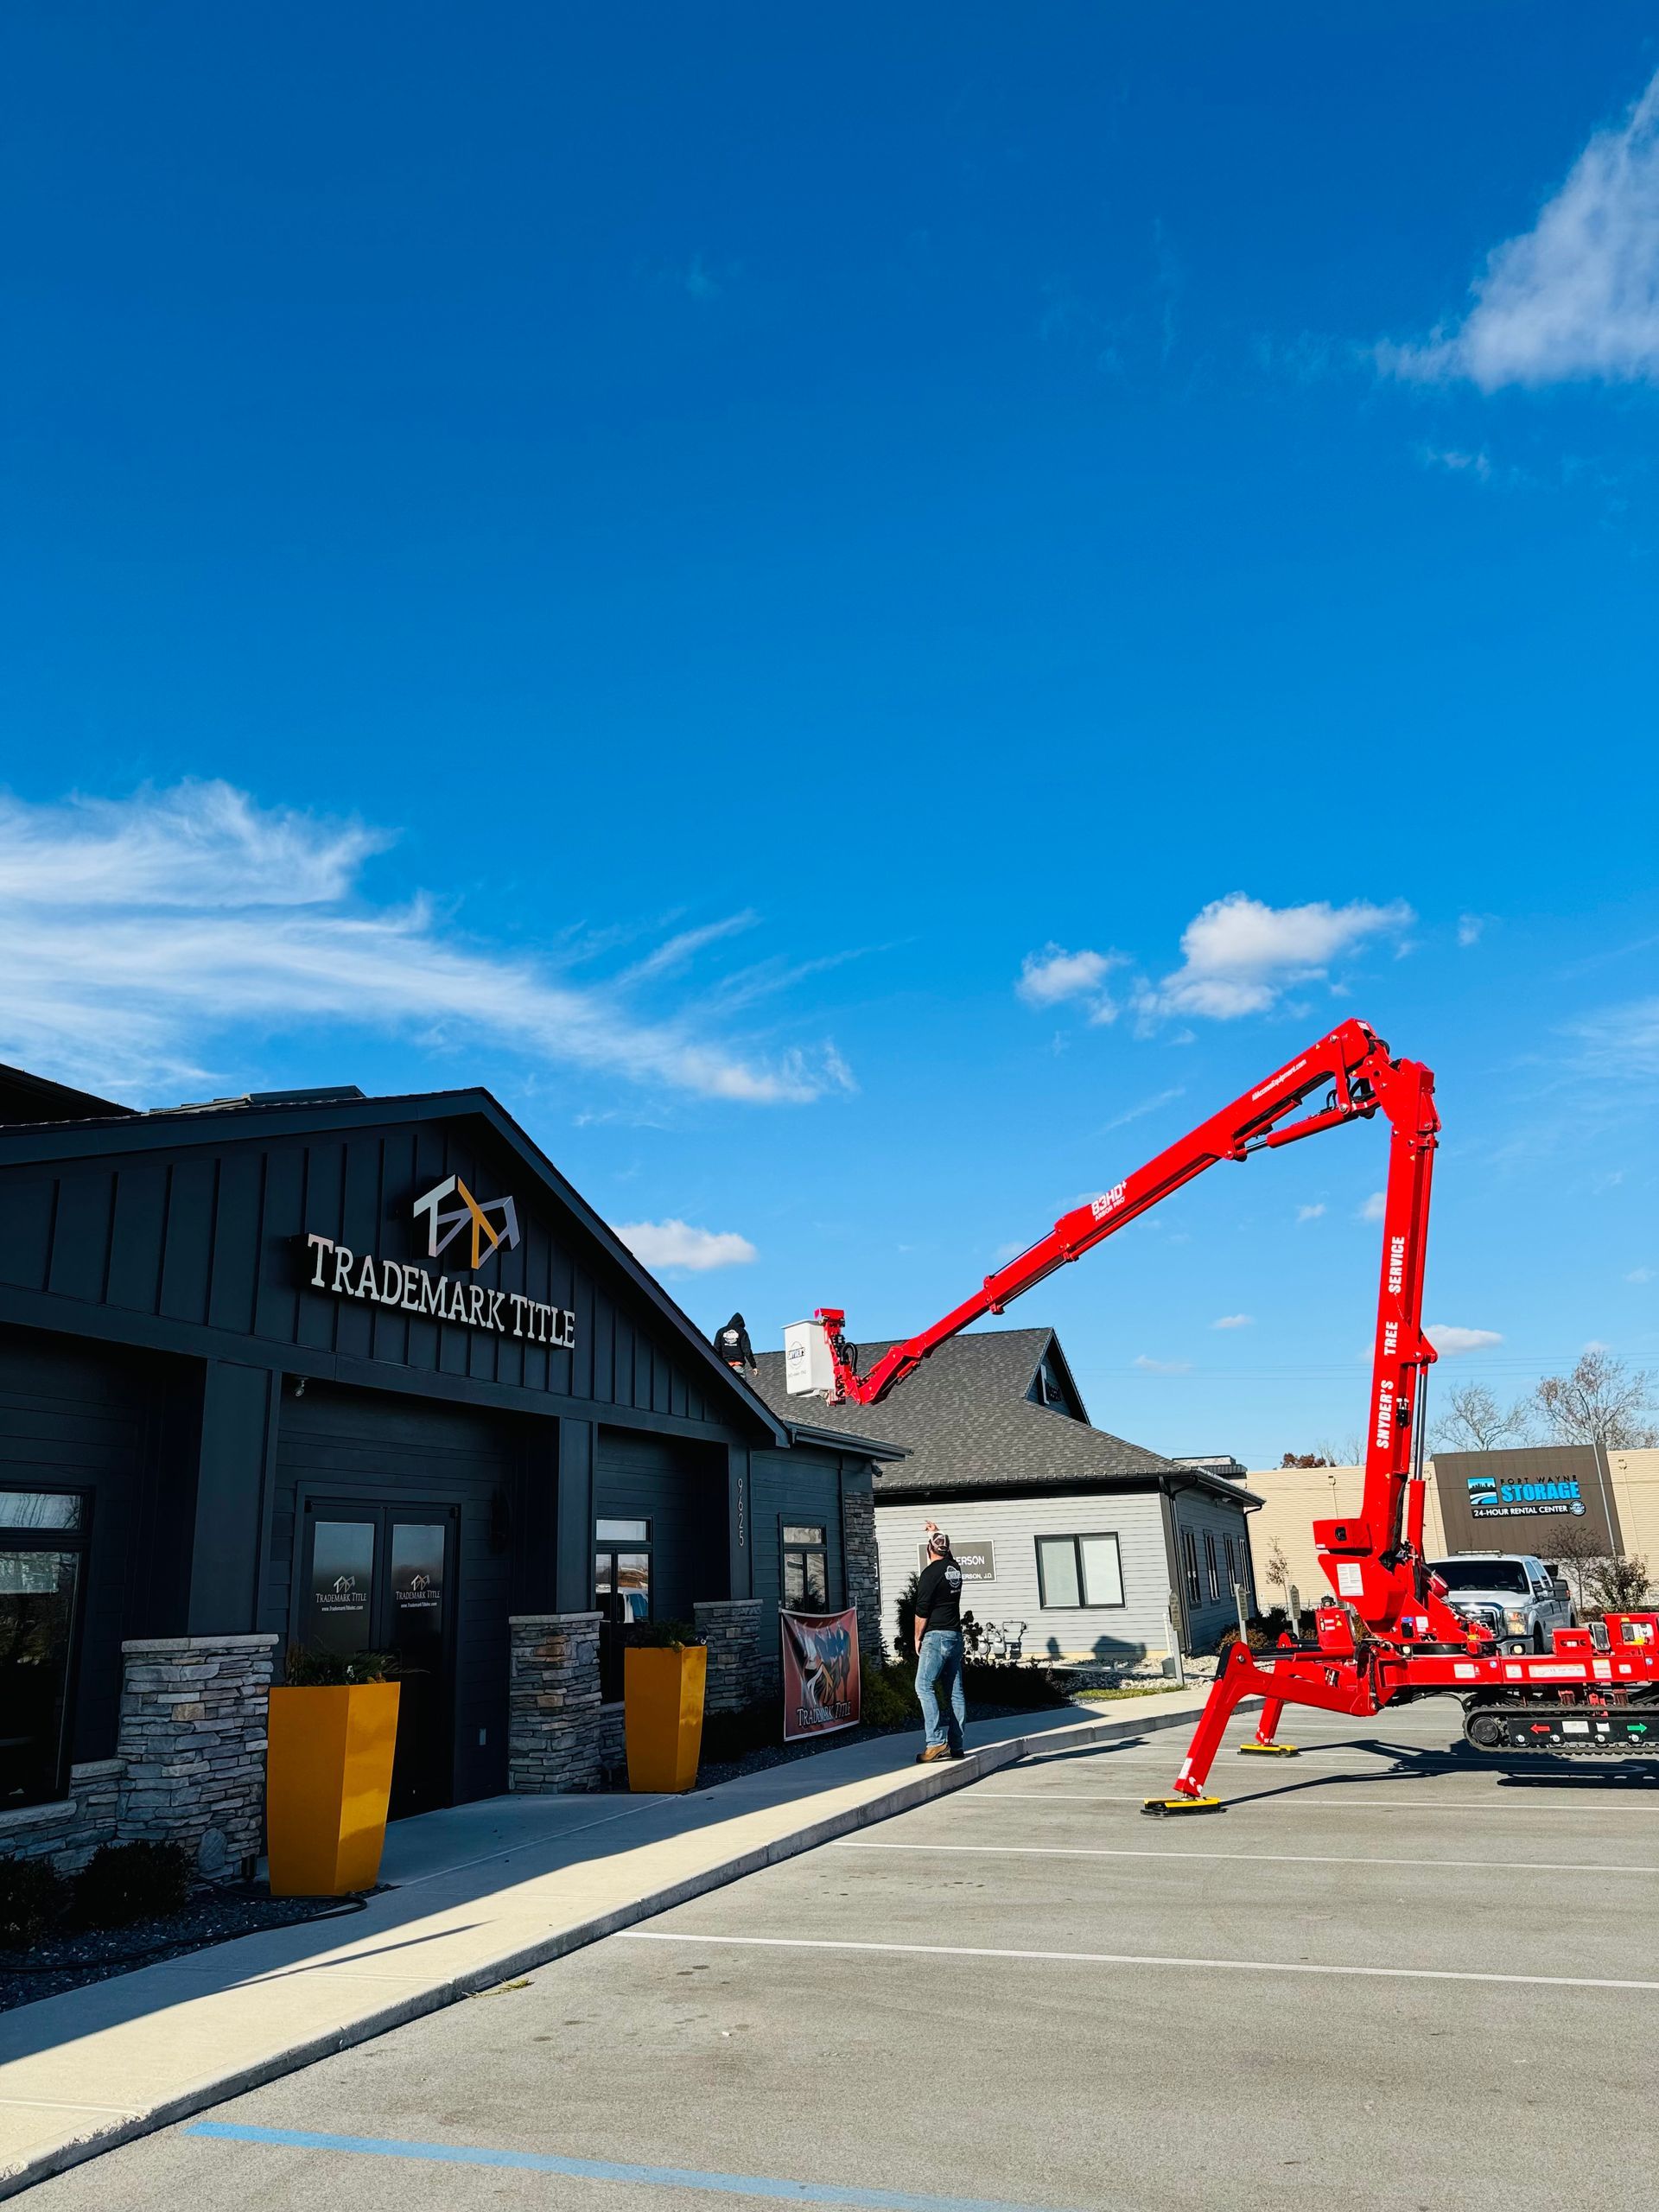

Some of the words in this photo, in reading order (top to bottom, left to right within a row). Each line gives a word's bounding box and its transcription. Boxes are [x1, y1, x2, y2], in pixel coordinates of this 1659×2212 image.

[1389, 1236, 1405, 1294] SERVICE
[308, 1233, 505, 1332] TRADEMARK
[510, 1293, 575, 1349] TITLE
[1384, 1321, 1398, 1356] TREE
[1376, 1380, 1394, 1449] SNYDER'S
[1500, 1477, 1529, 1485] FORT
[1536, 1474, 1578, 1484] WAYNE
[1500, 1481, 1580, 1503] STORAGE
[1473, 1507, 1510, 1517] 24-HOUR
[1510, 1505, 1538, 1516] RENTAL
[1538, 1504, 1568, 1514] CENTER
[953, 1556, 985, 1566] ERSON
[315, 1592, 351, 1604] TRADEMARK
[352, 1592, 367, 1602] TITLE
[396, 1591, 426, 1600] TRADEMARK
[427, 1589, 441, 1599] TITLE
